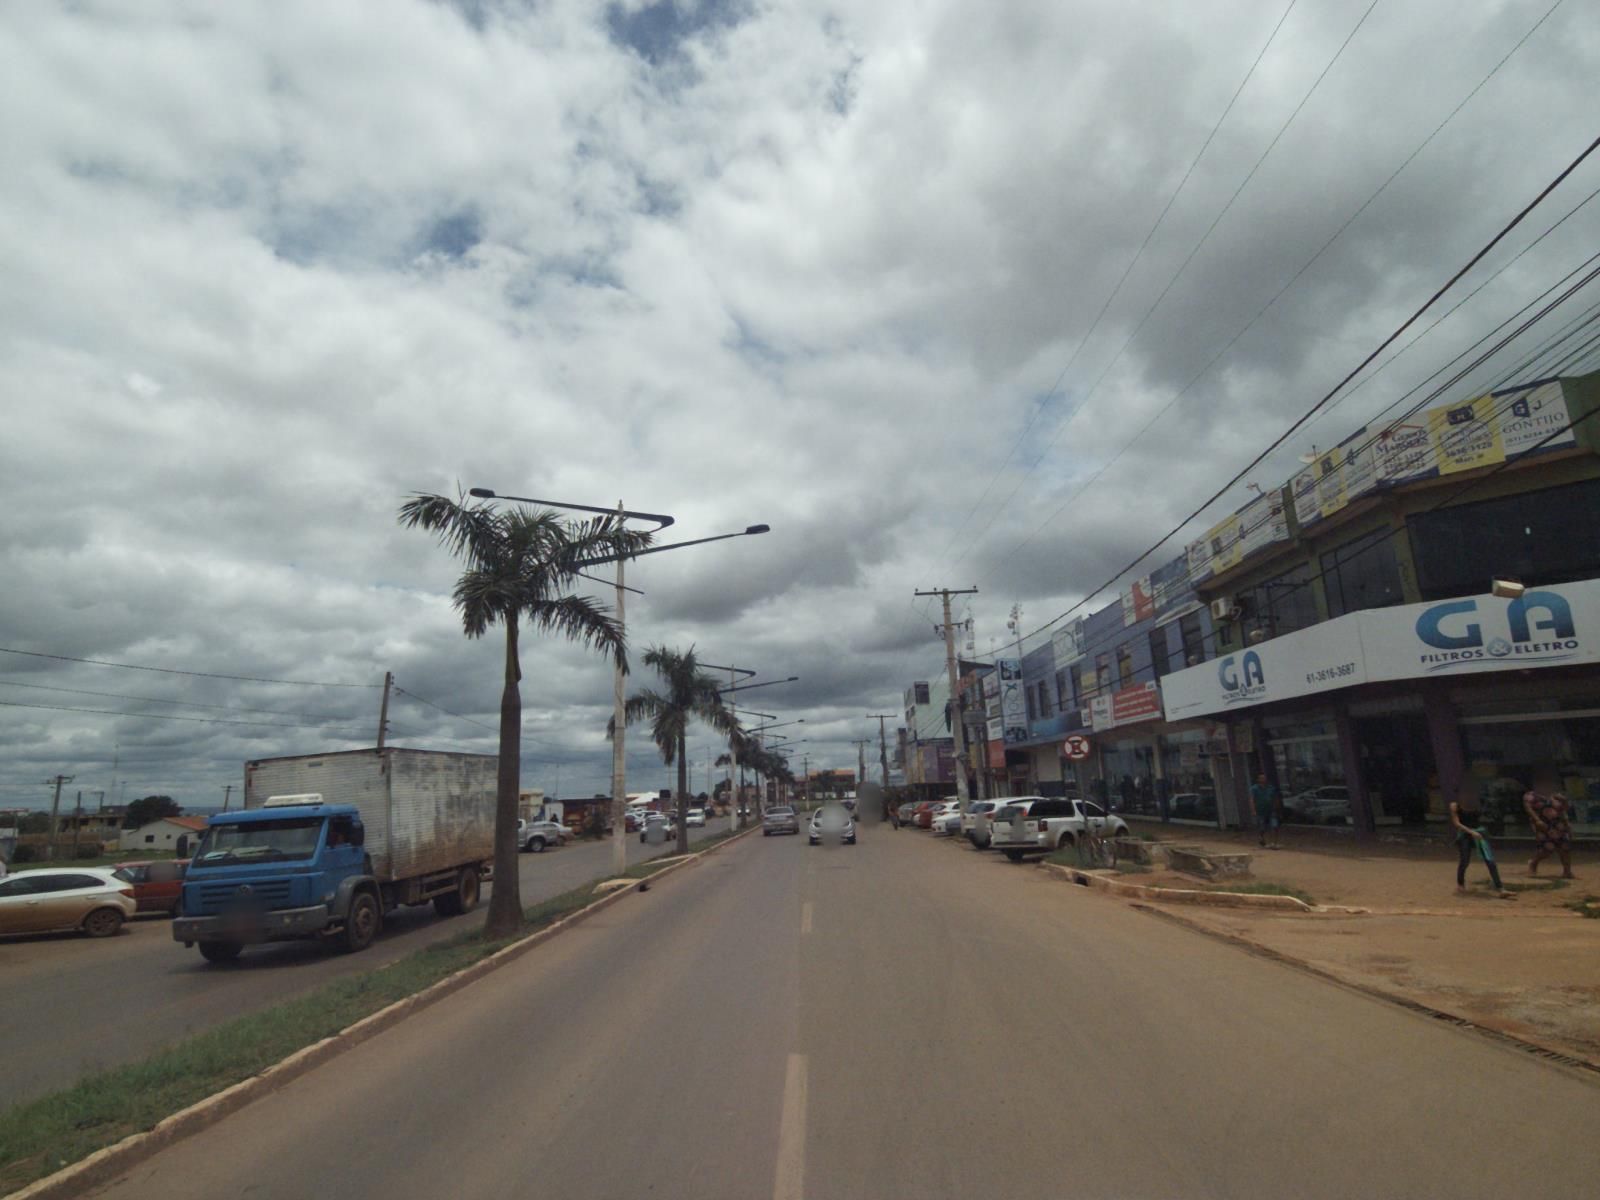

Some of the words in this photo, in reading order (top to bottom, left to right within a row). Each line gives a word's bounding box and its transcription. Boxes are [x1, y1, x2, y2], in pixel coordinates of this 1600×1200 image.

[1503, 412, 1565, 434] GONTIJO
[1421, 649, 1483, 663] FILTROS
[1515, 640, 1578, 654] ELETRO
